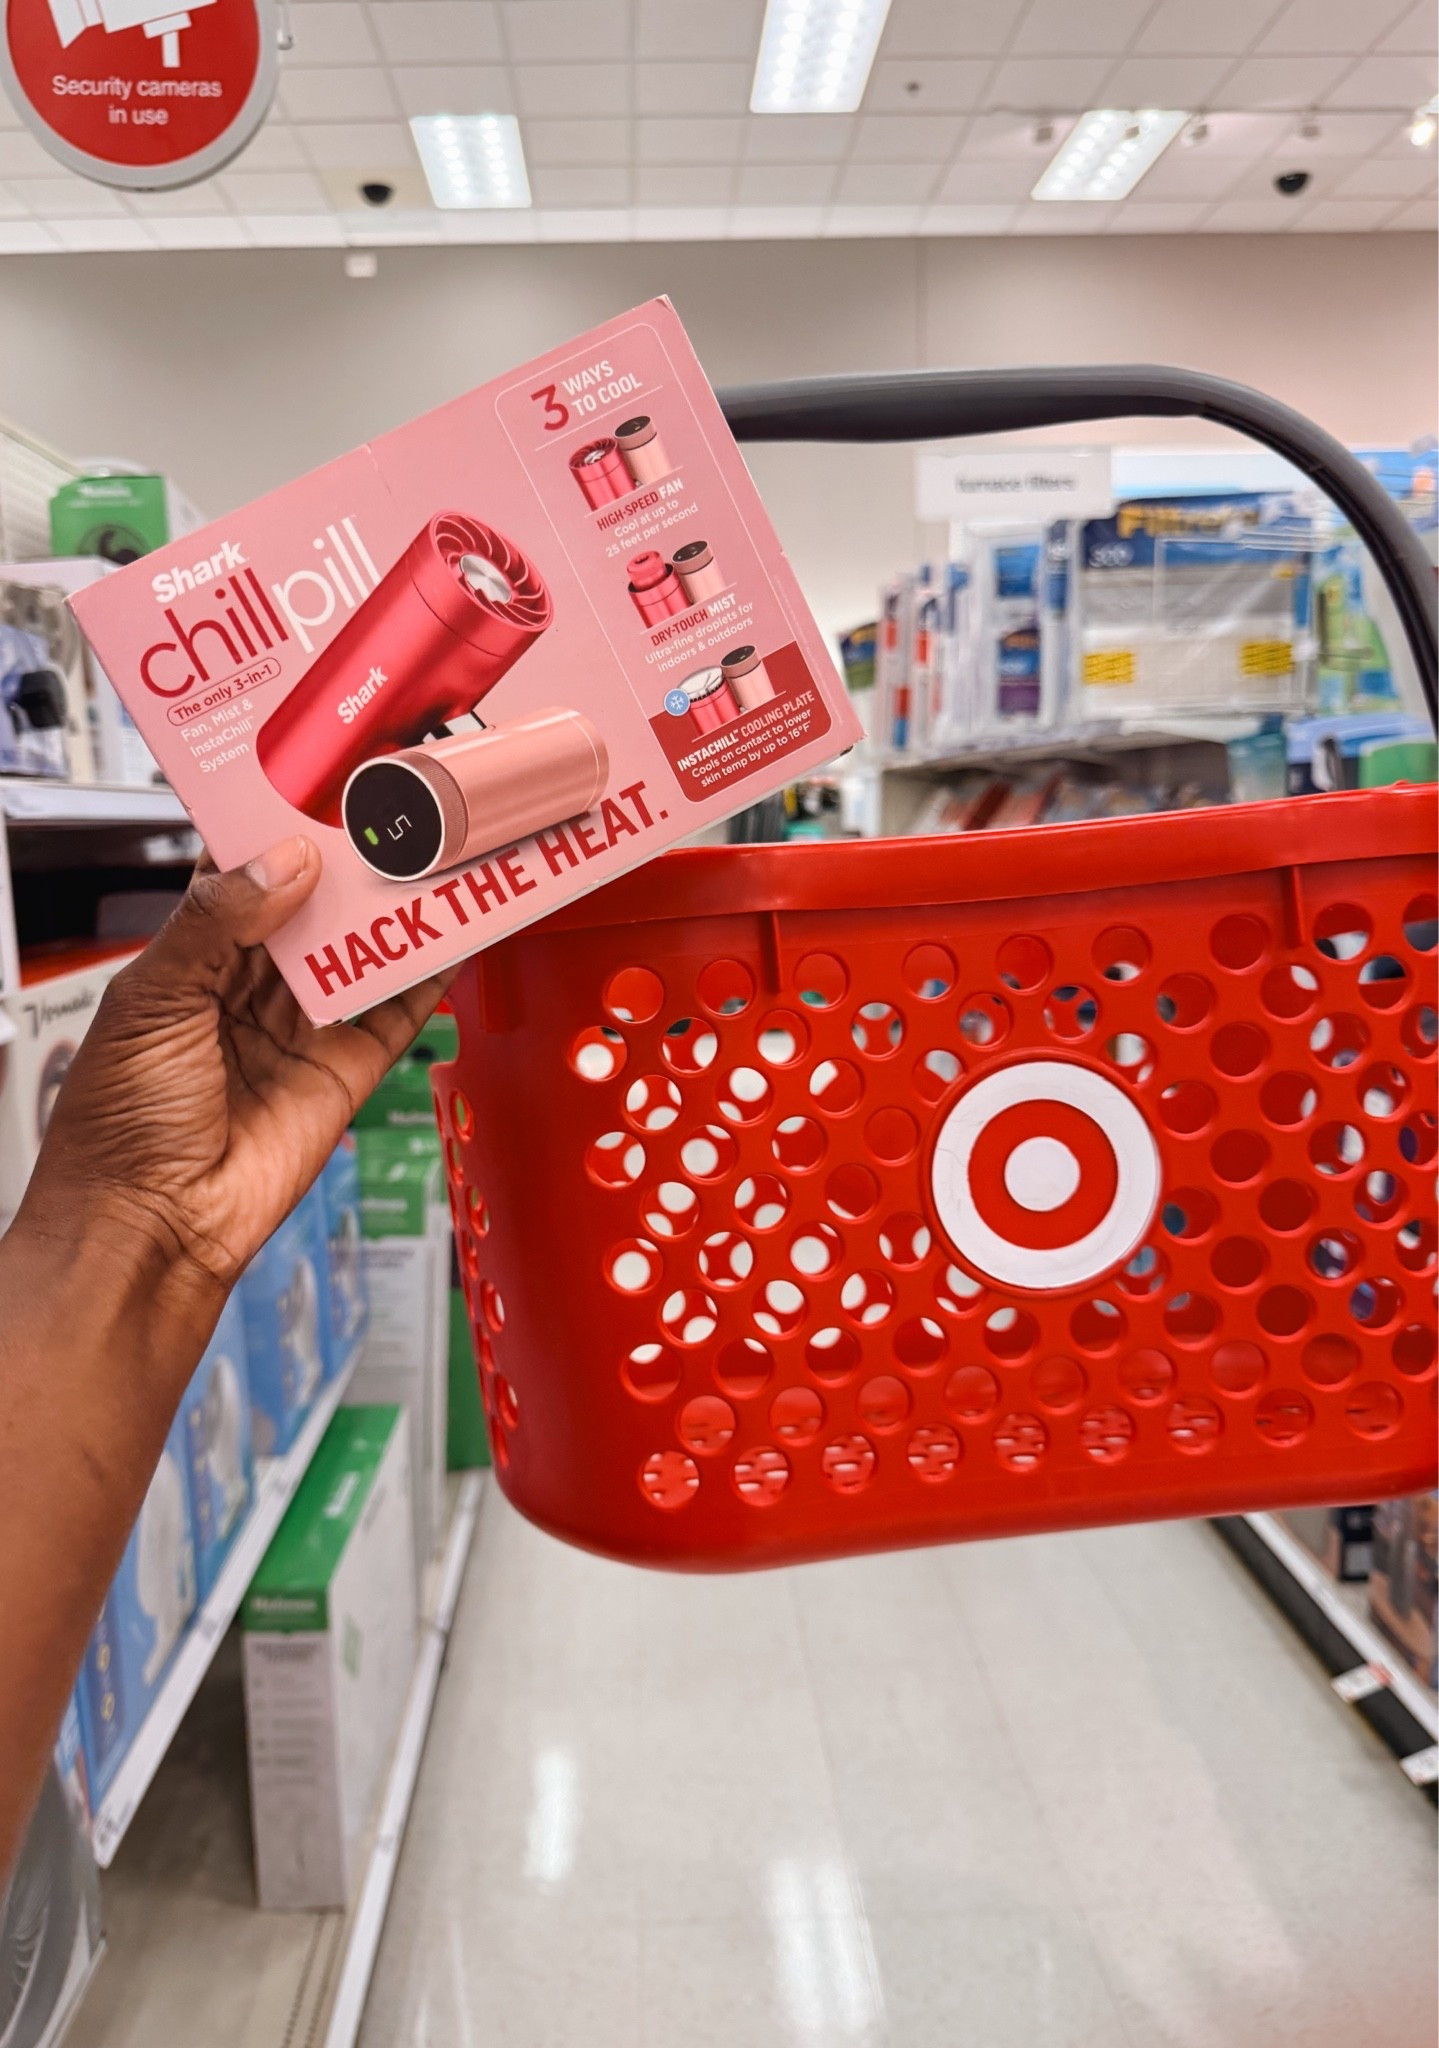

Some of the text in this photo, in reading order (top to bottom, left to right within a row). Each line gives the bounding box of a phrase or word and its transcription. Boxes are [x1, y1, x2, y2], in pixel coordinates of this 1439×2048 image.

[52, 75, 223, 101] Security cameras
[108, 104, 169, 125] in use
[562, 360, 614, 396] WAYS
[571, 373, 643, 416] TO COOL
[530, 383, 570, 431] 3
[597, 478, 684, 531] HIGH-SPEED FAN
[605, 502, 698, 557] 25 feet per second
[614, 500, 679, 538] Cool at up to
[151, 541, 246, 603] Shark
[645, 602, 753, 664] Ultra-fine droplets for
[650, 593, 736, 646] DRY-TOUCH MIST
[698, 642, 706, 651] &
[707, 617, 753, 647] outdoors
[174, 664, 273, 720] The only 3-in-1
[337, 666, 388, 724] Shark
[740, 708, 784, 737] COOLING
[782, 690, 815, 715] PLATE
[181, 699, 253, 741] Fan, Mist &
[691, 709, 812, 778] Cools on contact to lower
[200, 743, 249, 773] System
[701, 774, 721, 788] skin
[721, 758, 748, 776] temp
[747, 750, 761, 763] by
[762, 742, 777, 754] up
[776, 735, 788, 745] to
[304, 780, 669, 997] HACK THE HEAT.
